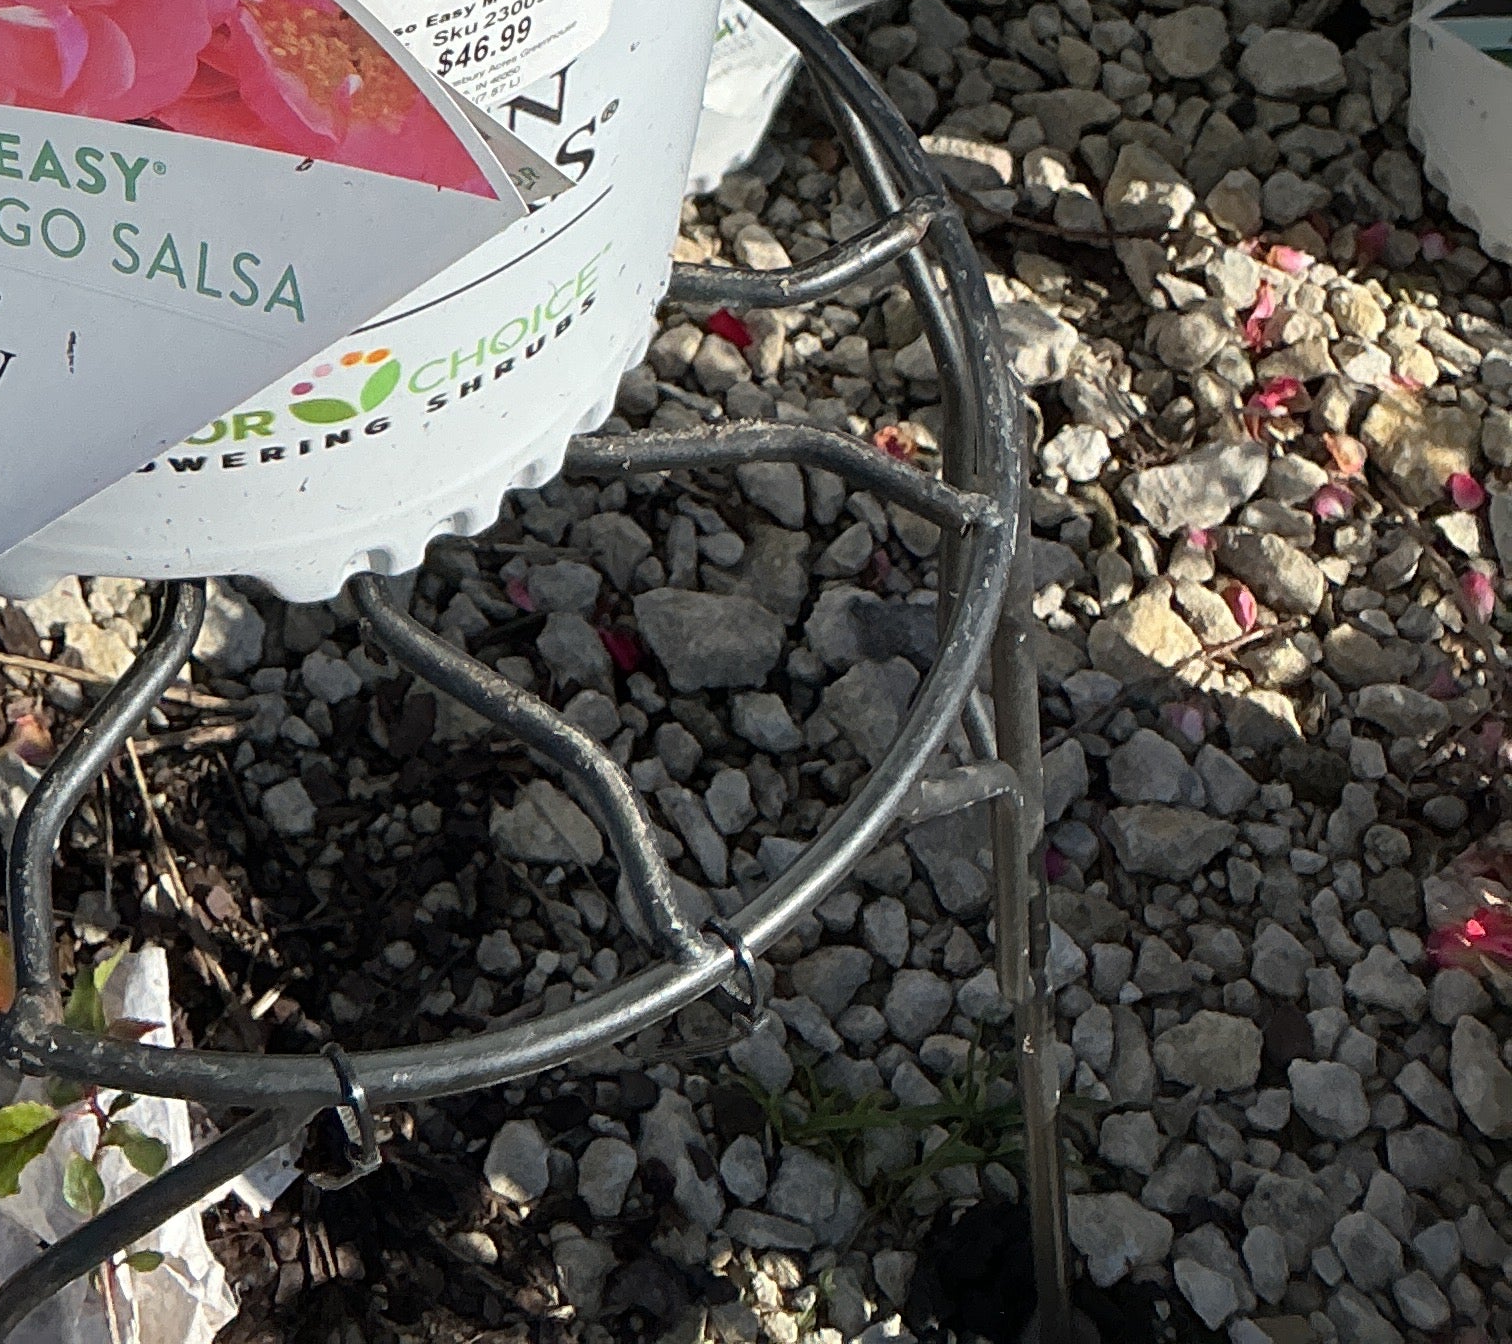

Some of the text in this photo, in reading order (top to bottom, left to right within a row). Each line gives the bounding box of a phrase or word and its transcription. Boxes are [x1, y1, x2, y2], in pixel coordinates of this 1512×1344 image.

[393, 22, 417, 36] so
[426, 2, 476, 29] Easy
[433, 20, 477, 47] Sku
[437, 15, 532, 78] $46.99
[112, 222, 306, 323] SALSA
[407, 257, 602, 395] CHOICE
[133, 415, 392, 474] WERING
[426, 290, 597, 414] SHRUBS
